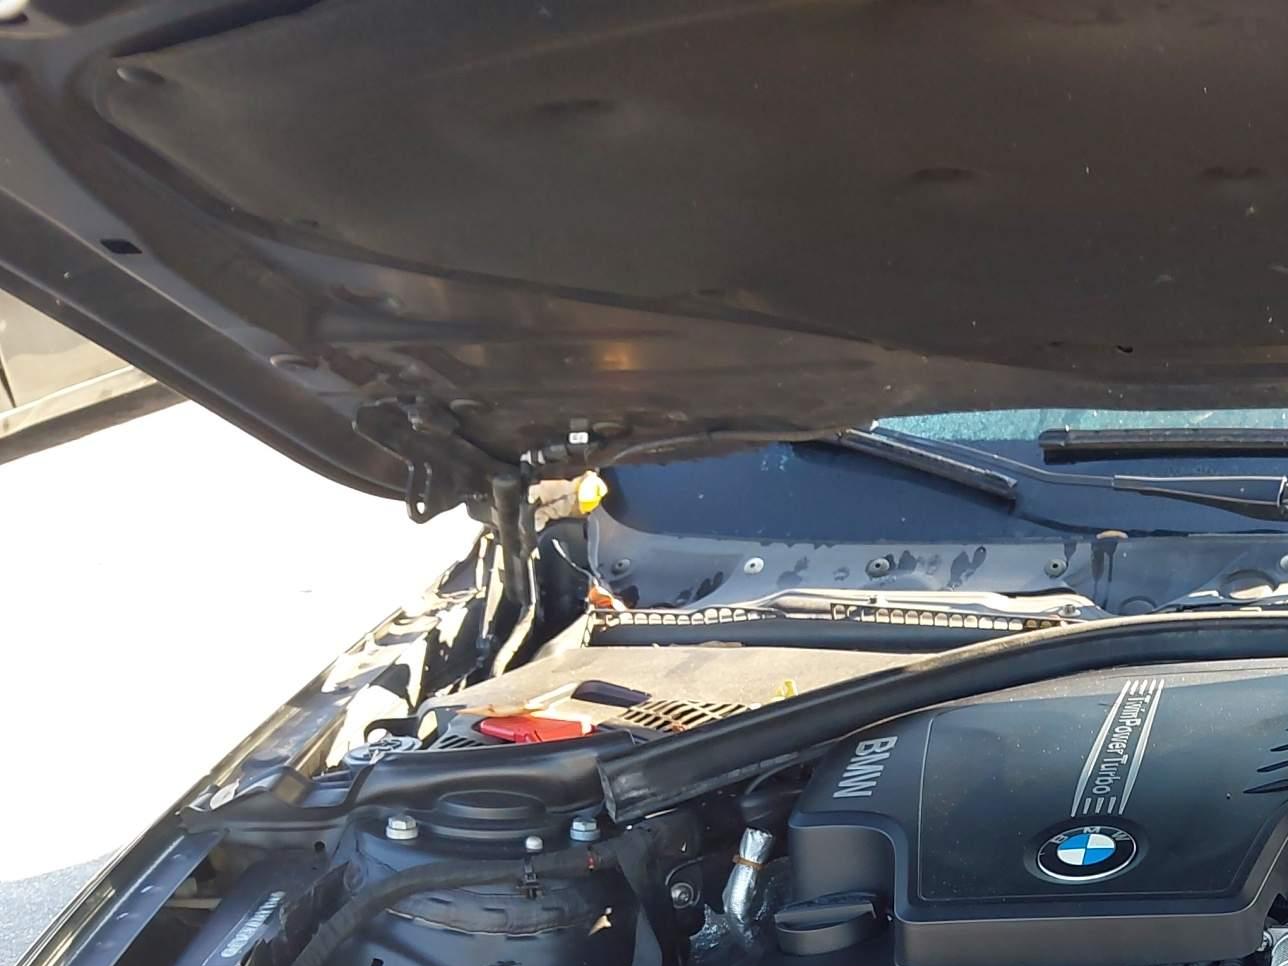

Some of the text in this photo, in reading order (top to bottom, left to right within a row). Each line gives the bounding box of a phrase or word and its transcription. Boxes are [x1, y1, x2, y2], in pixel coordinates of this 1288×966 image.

[832, 736, 898, 798] BMW
[1092, 754, 1129, 795] Turbo
[1049, 826, 1131, 844] BMW
